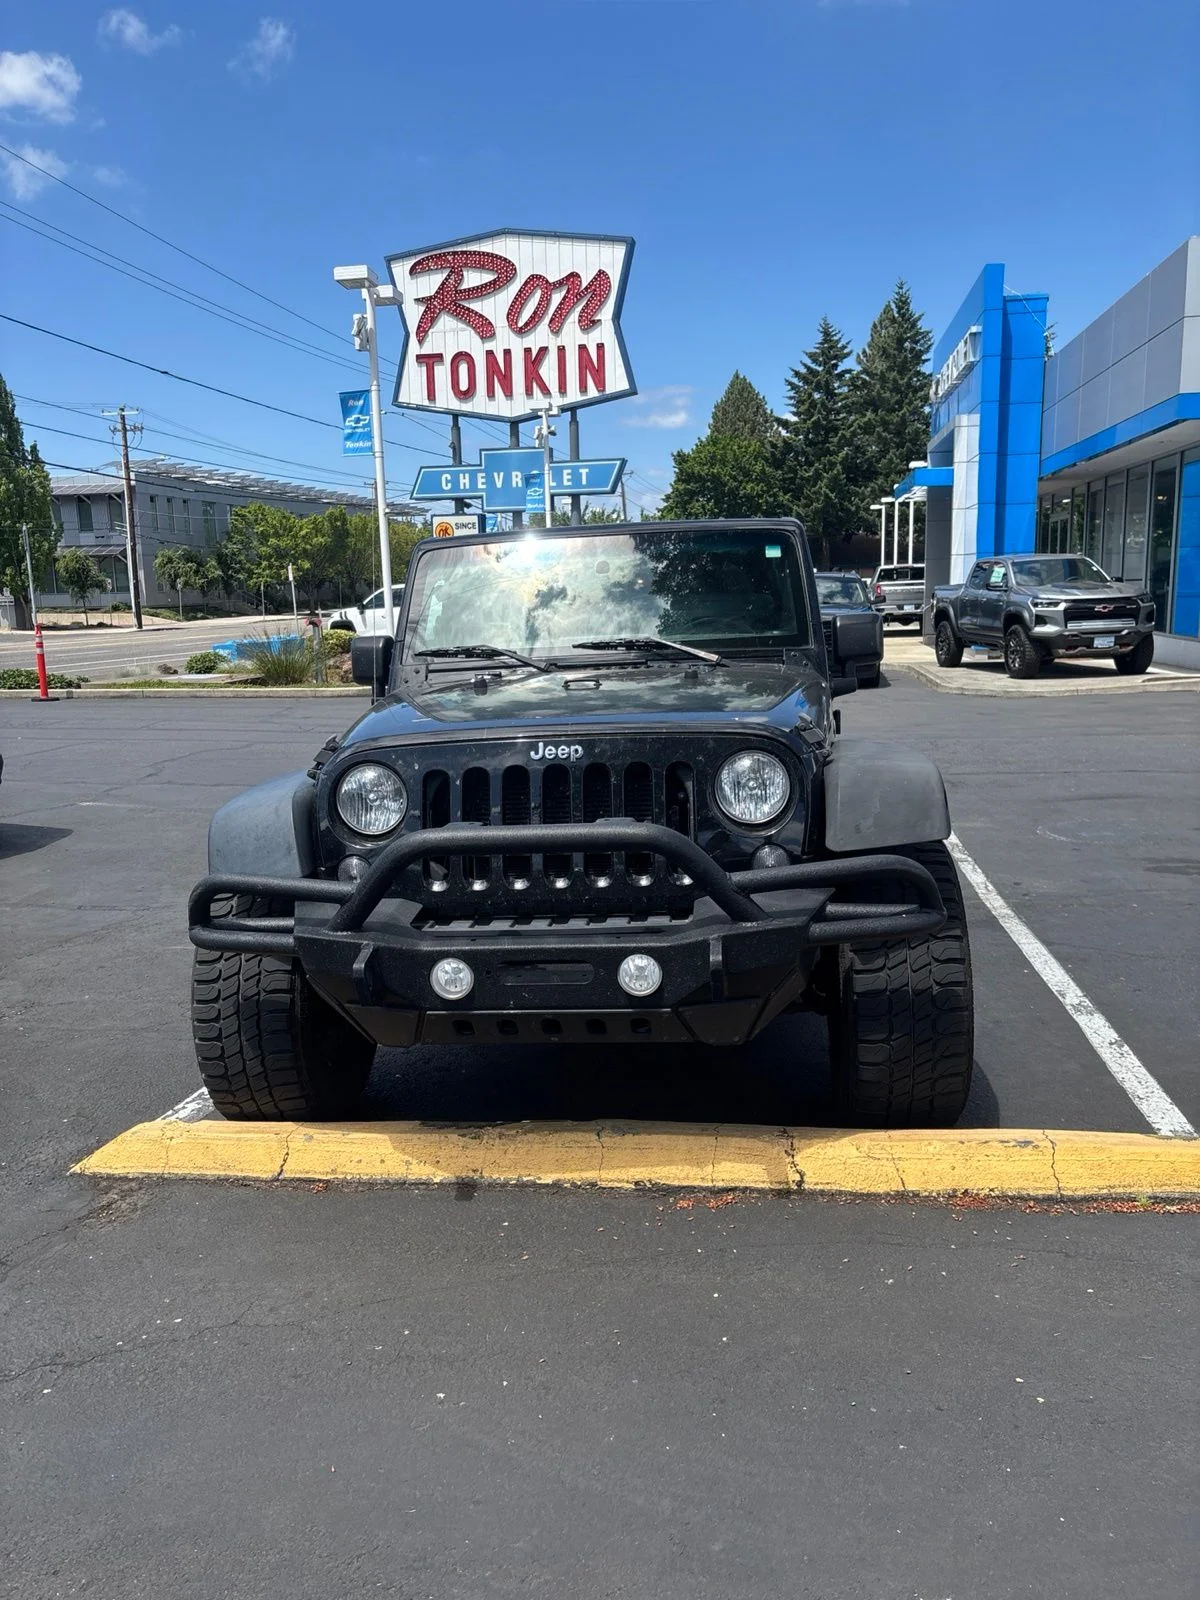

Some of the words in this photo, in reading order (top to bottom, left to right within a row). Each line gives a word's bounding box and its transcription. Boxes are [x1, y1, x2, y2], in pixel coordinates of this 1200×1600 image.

[409, 250, 612, 345] Ron
[416, 342, 607, 401] TONKIN
[441, 468, 590, 491] CHEVRLET
[454, 522, 477, 530] SINCE
[530, 742, 584, 762] Jeep
